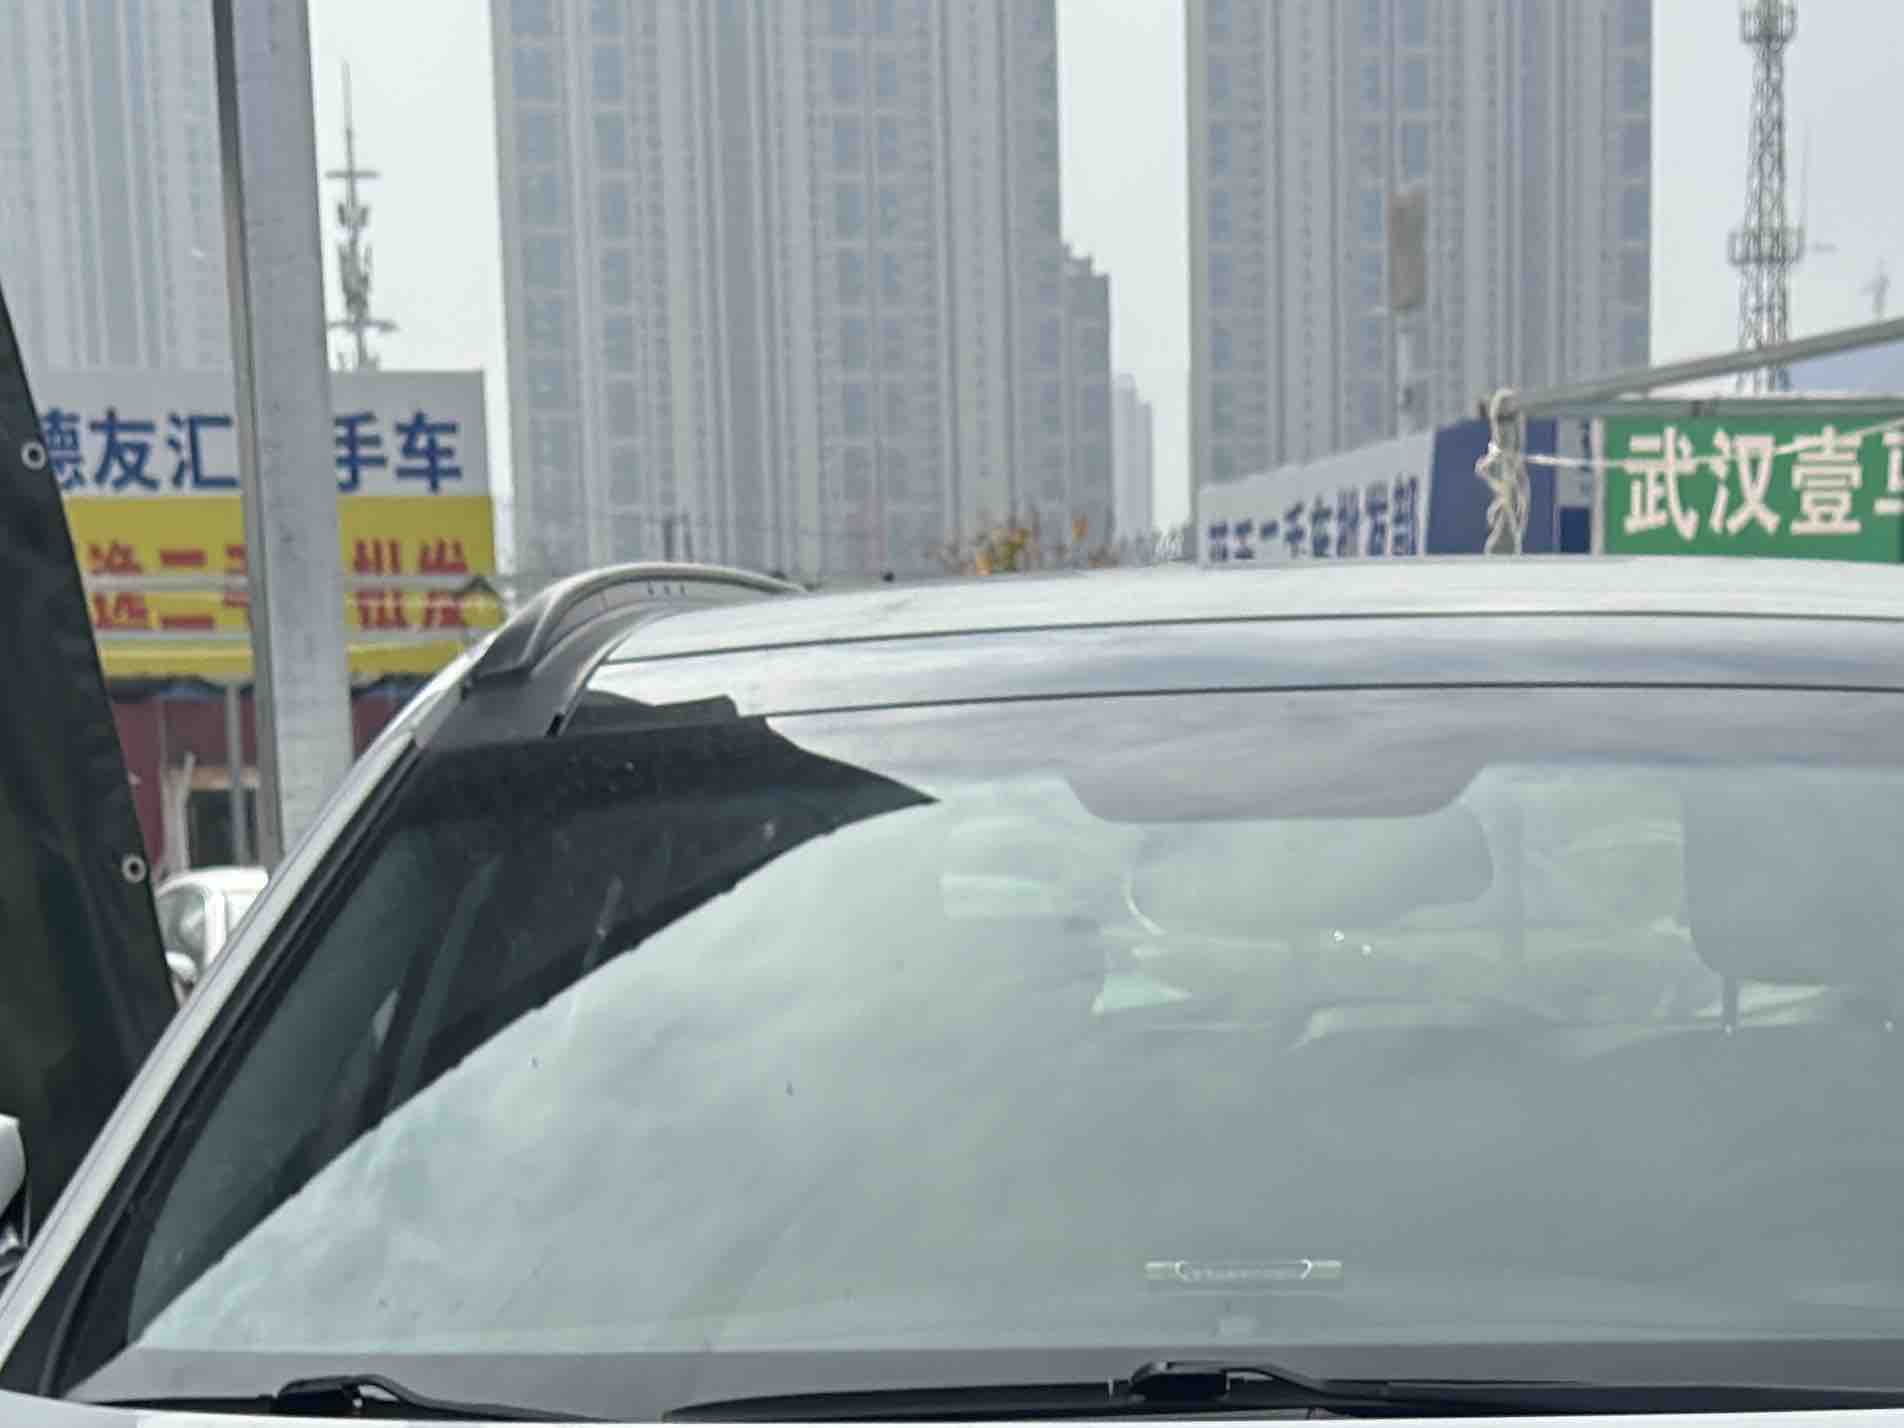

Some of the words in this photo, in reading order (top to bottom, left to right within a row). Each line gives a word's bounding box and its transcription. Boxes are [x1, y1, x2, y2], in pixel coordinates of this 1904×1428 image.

[43, 408, 463, 492] 德友汇手车
